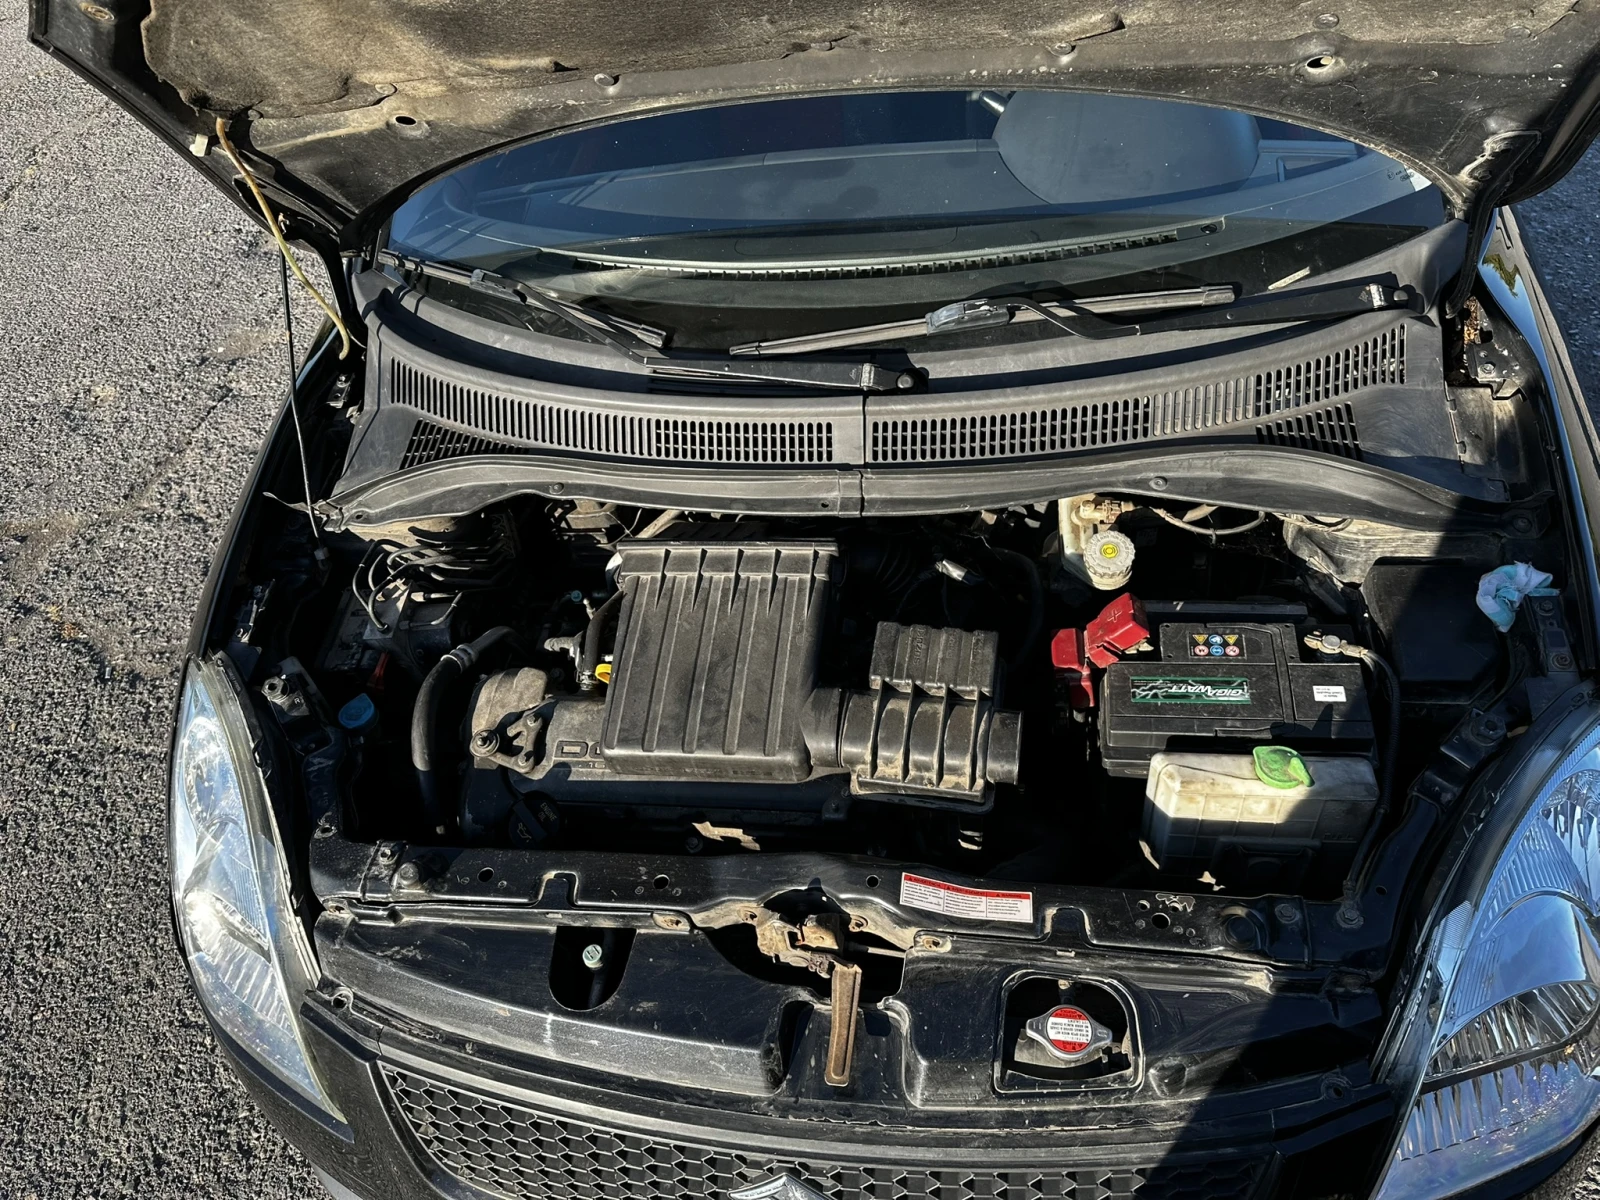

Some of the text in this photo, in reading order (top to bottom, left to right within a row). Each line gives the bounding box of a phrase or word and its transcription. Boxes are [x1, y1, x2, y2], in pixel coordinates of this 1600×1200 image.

[913, 629, 926, 664] SUZUKI
[1168, 684, 1243, 697] GIGAWATT
[538, 811, 546, 822] OIL
[540, 802, 557, 822] ENGINE
